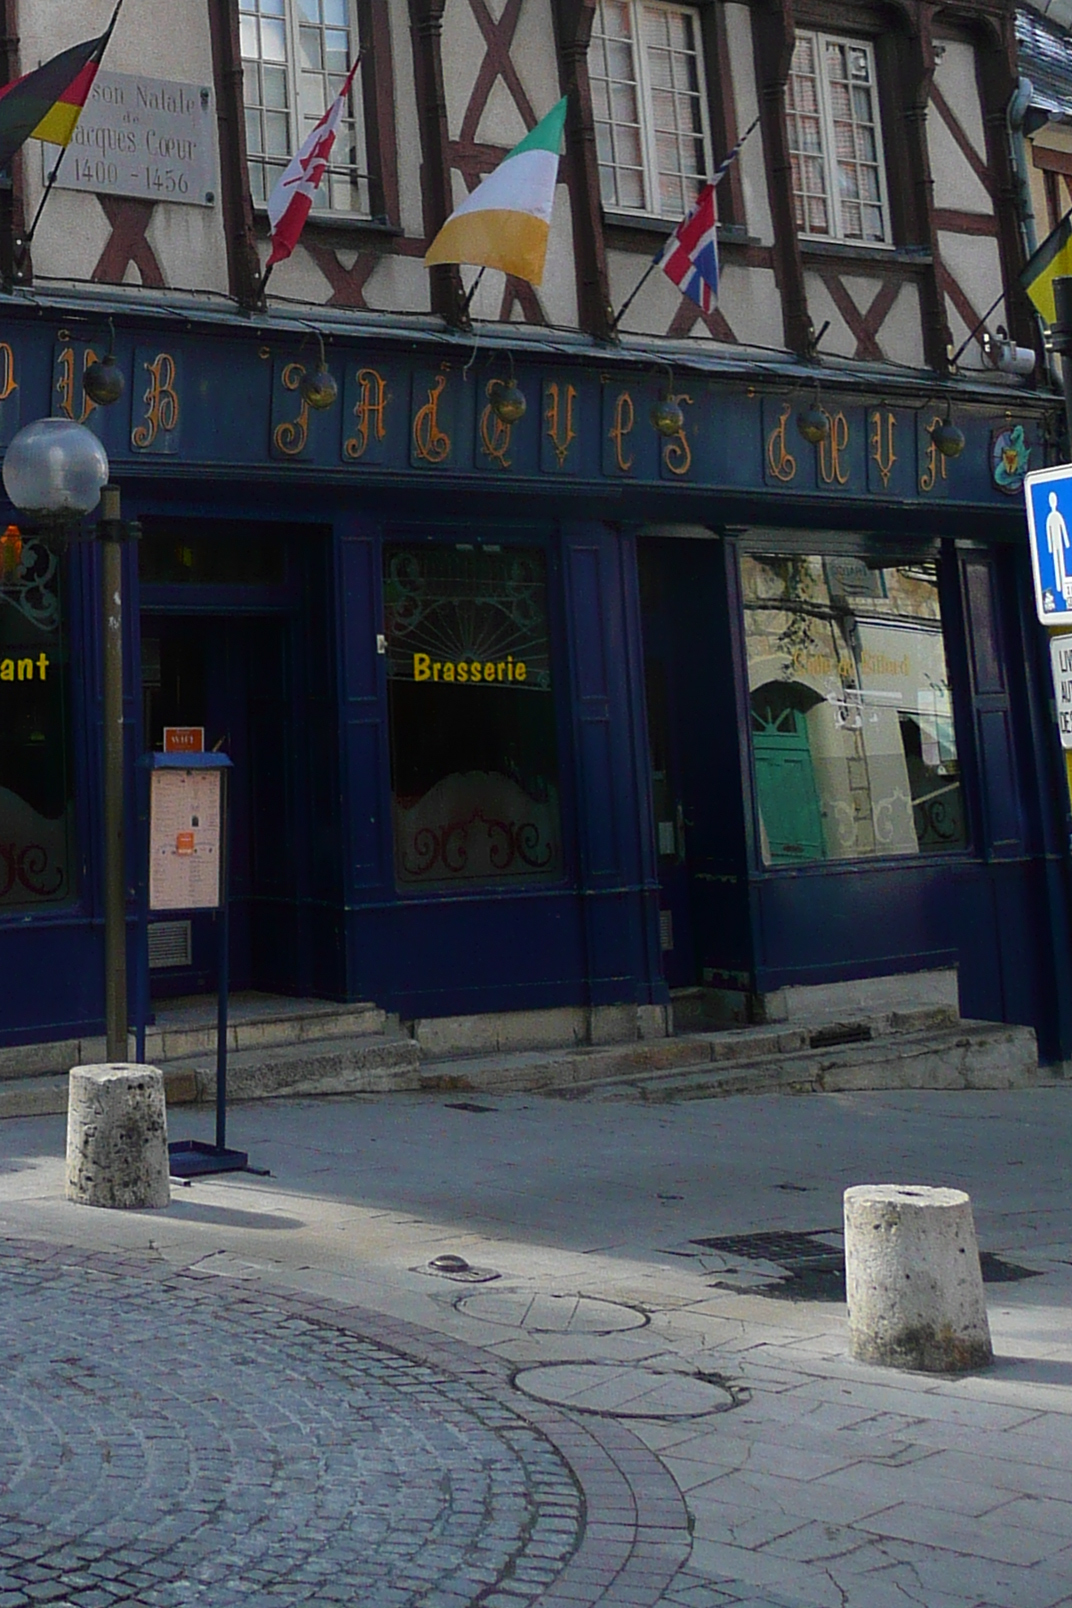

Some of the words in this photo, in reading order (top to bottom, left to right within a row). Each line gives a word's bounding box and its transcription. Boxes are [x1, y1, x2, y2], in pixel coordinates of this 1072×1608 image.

[91, 83, 124, 105] son
[136, 85, 195, 115] Natale
[122, 111, 140, 124] de
[74, 125, 137, 158] acques
[74, 159, 118, 183] 1400
[145, 166, 189, 194] 1456
[413, 653, 528, 682] Brasserie
